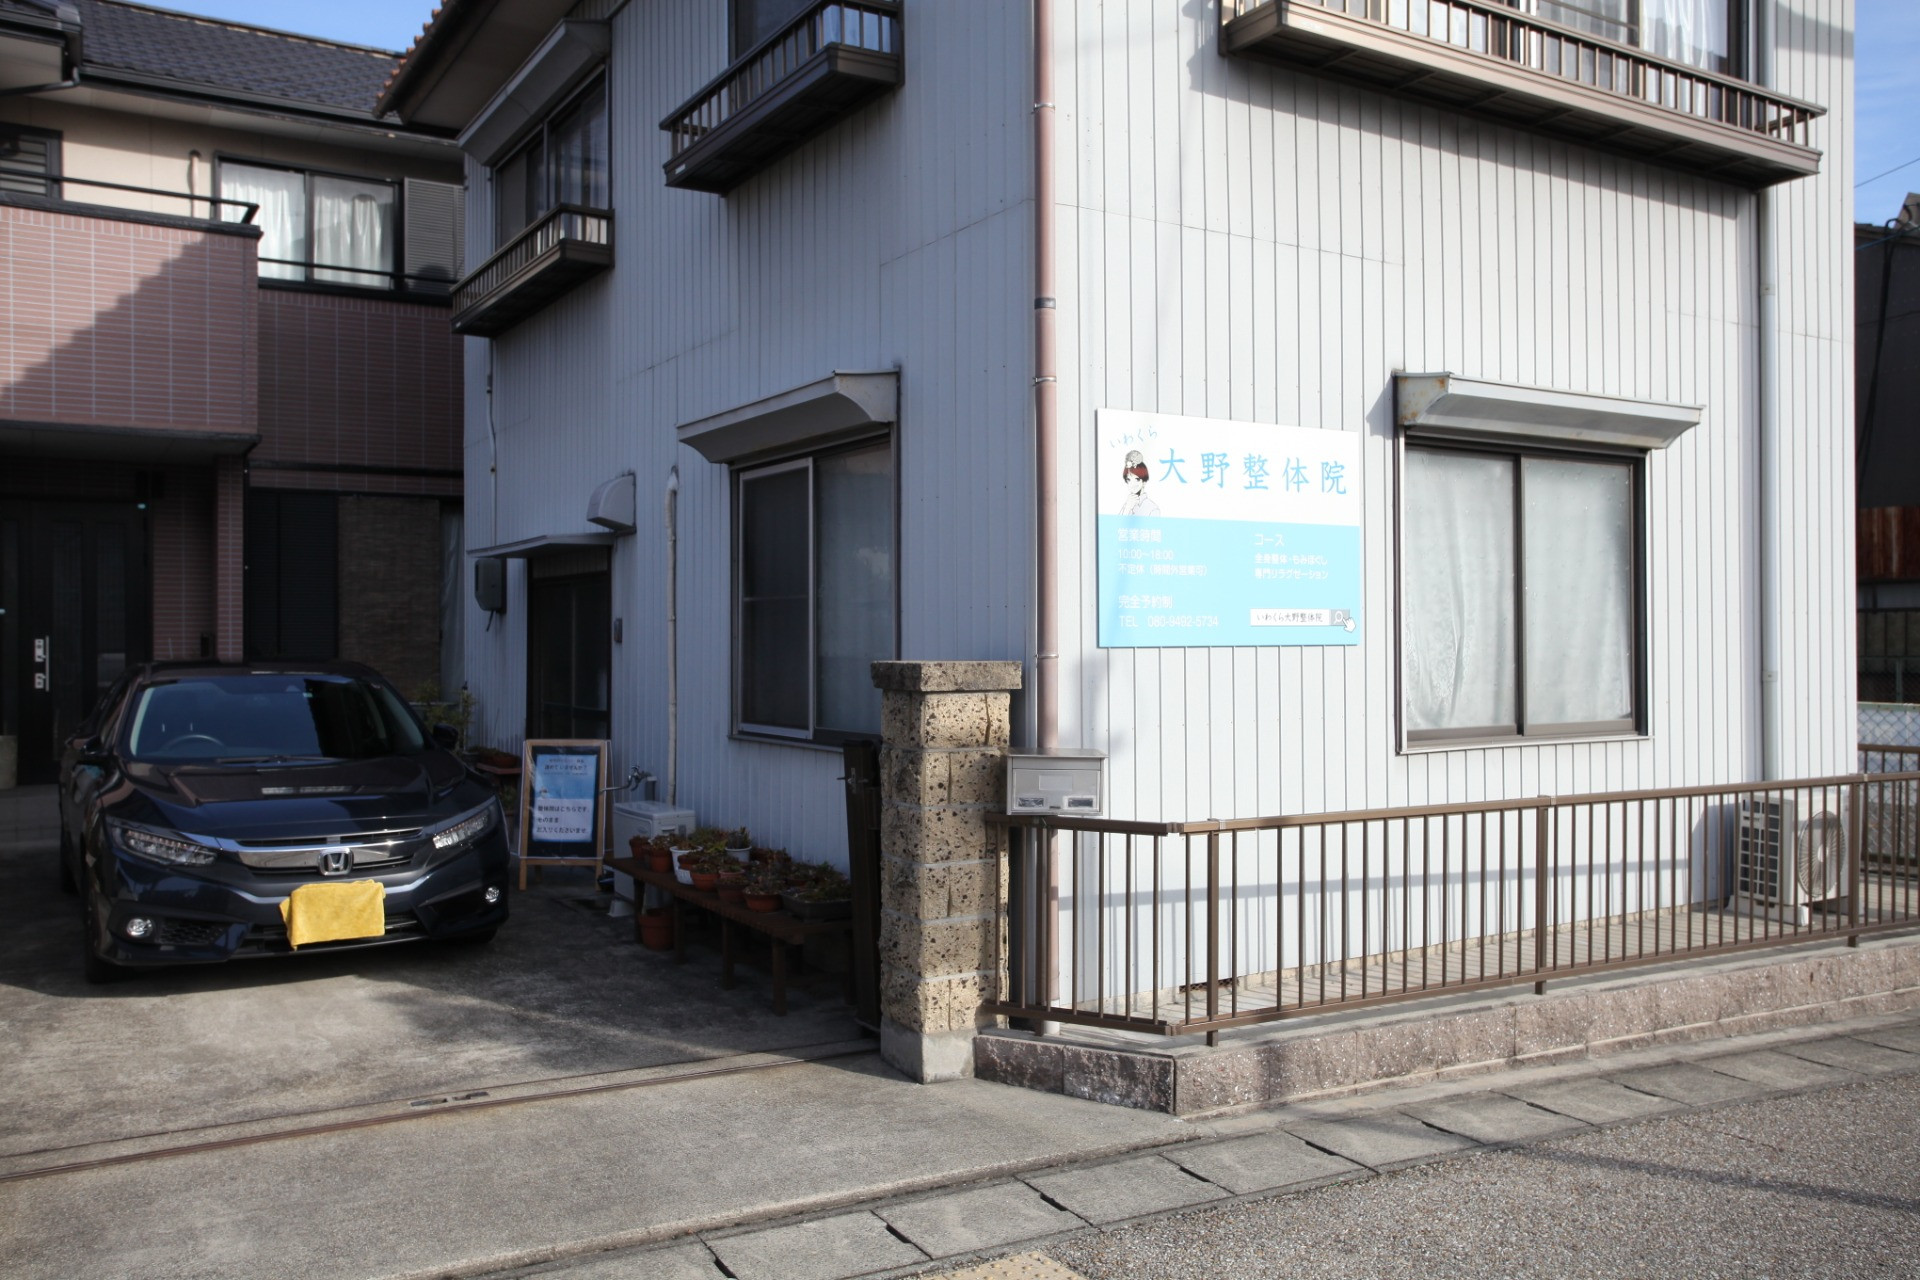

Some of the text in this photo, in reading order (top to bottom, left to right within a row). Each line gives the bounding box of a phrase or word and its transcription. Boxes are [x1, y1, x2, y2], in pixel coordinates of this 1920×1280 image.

[1109, 425, 1158, 448] いわくら
[1158, 447, 1347, 495] 大野整体院
[1118, 528, 1162, 543] 営業時間
[1254, 534, 1284, 546] コース
[1118, 594, 1172, 608] 完全予約制
[1119, 615, 1139, 627] TEL
[1256, 612, 1323, 623] いわくら大野整体院
